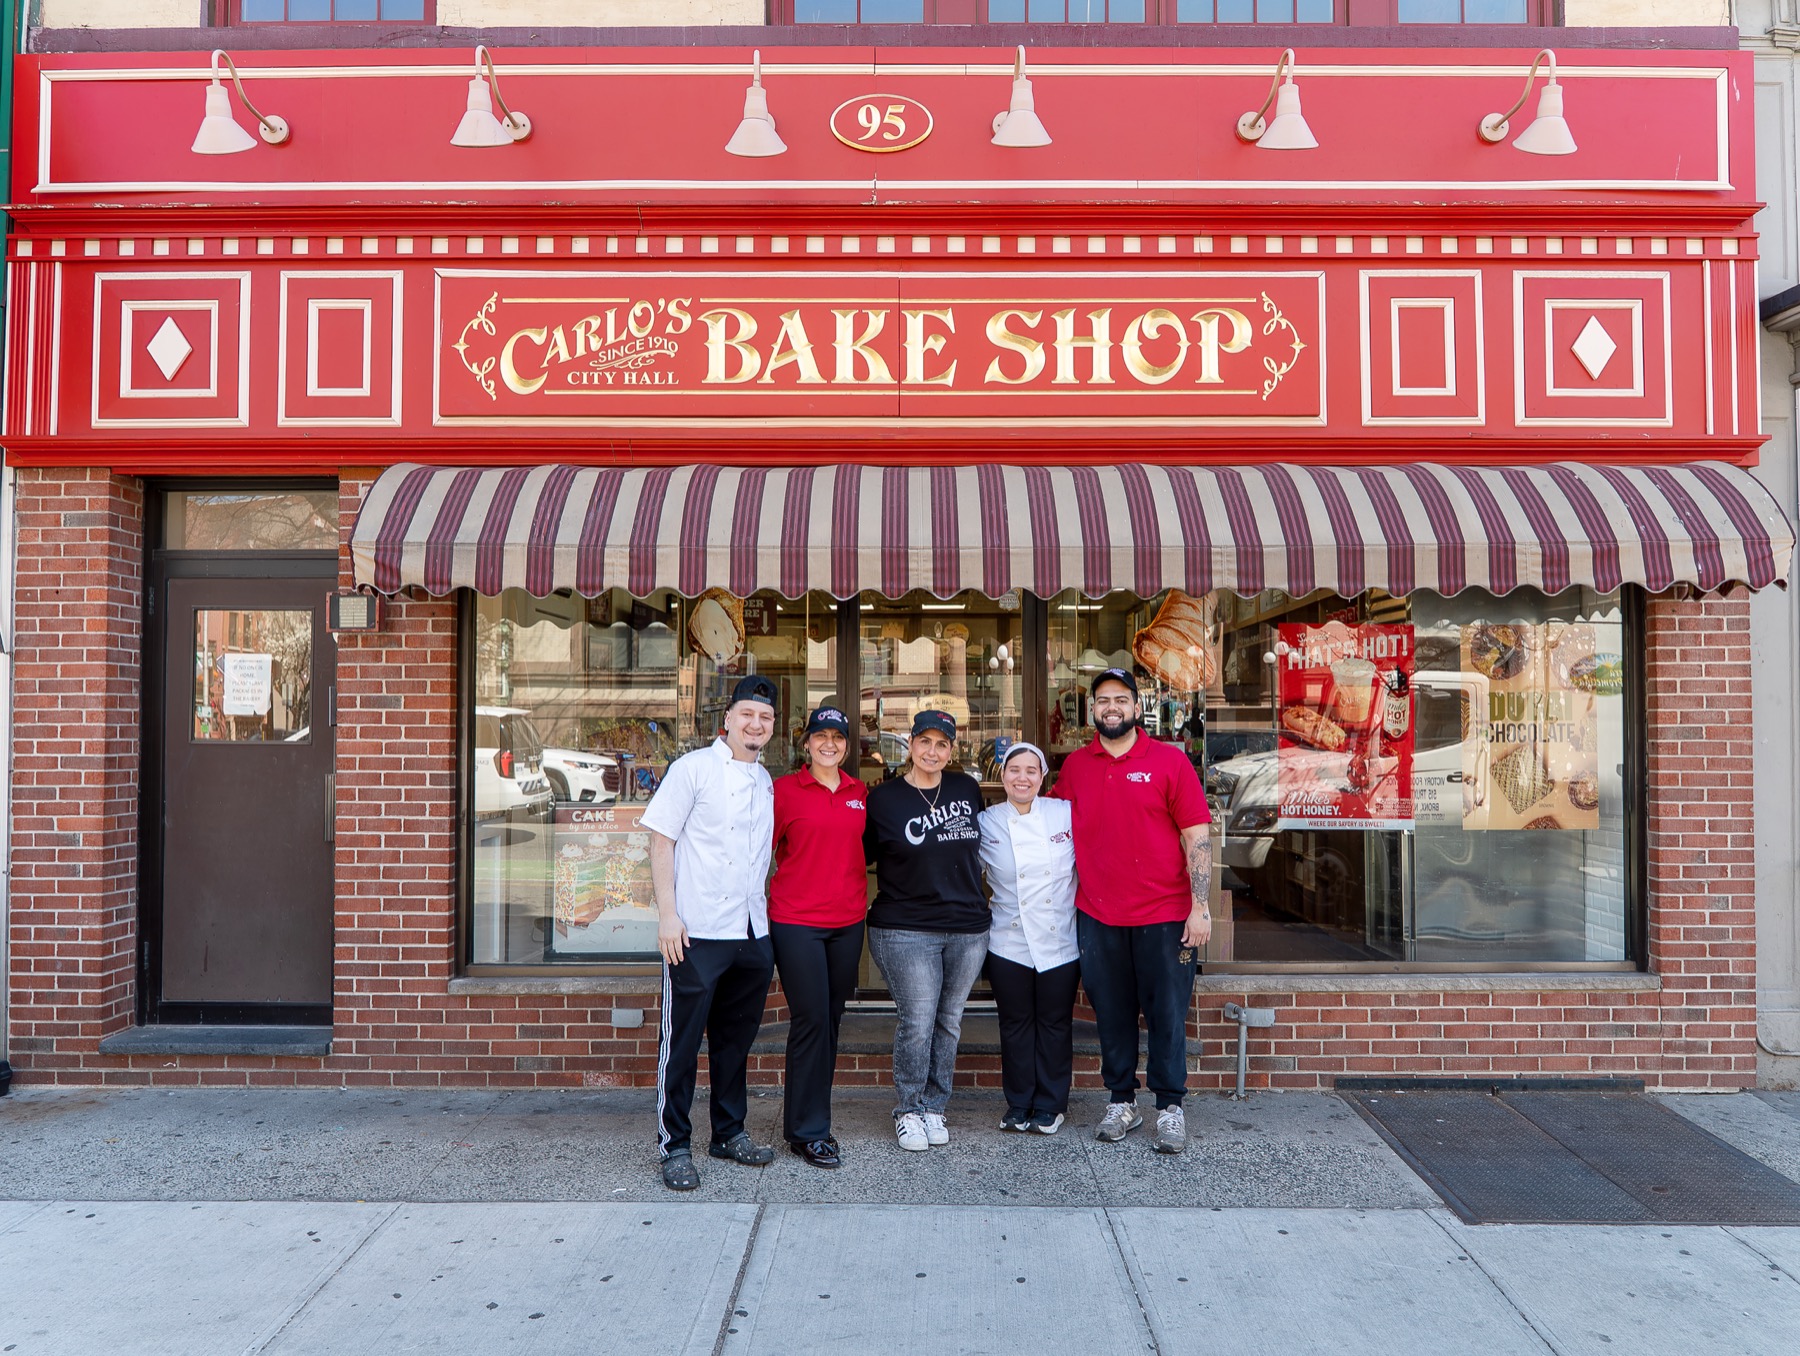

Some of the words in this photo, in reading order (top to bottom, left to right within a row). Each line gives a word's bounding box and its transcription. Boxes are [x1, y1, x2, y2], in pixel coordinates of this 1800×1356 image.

[857, 103, 906, 141] 95
[500, 297, 693, 395] CARLO'S
[697, 307, 958, 388] BAKE
[984, 307, 1253, 385] SHOP
[598, 338, 645, 363] SINCE
[647, 336, 679, 354] 1910
[566, 371, 617, 385] CITY
[623, 371, 680, 385] HALL
[1288, 640, 1356, 670] THAT'S
[1362, 634, 1408, 660] HOT!
[1387, 709, 1406, 720] HOT
[1488, 722, 1576, 743] CHOCOLATE
[572, 810, 615, 822] CAKE
[1280, 804, 1302, 816] HOT
[1303, 804, 1342, 816] HONEY.
[569, 823, 580, 832] by
[598, 822, 619, 830] slice
[905, 800, 972, 846] CARLO'S
[1308, 820, 1326, 828] WHERE
[1327, 820, 1338, 828] OUR
[1338, 820, 1358, 828] SAVORY
[1359, 820, 1364, 828] IS
[937, 832, 960, 842] BAKE
[960, 831, 979, 839] SHOP
